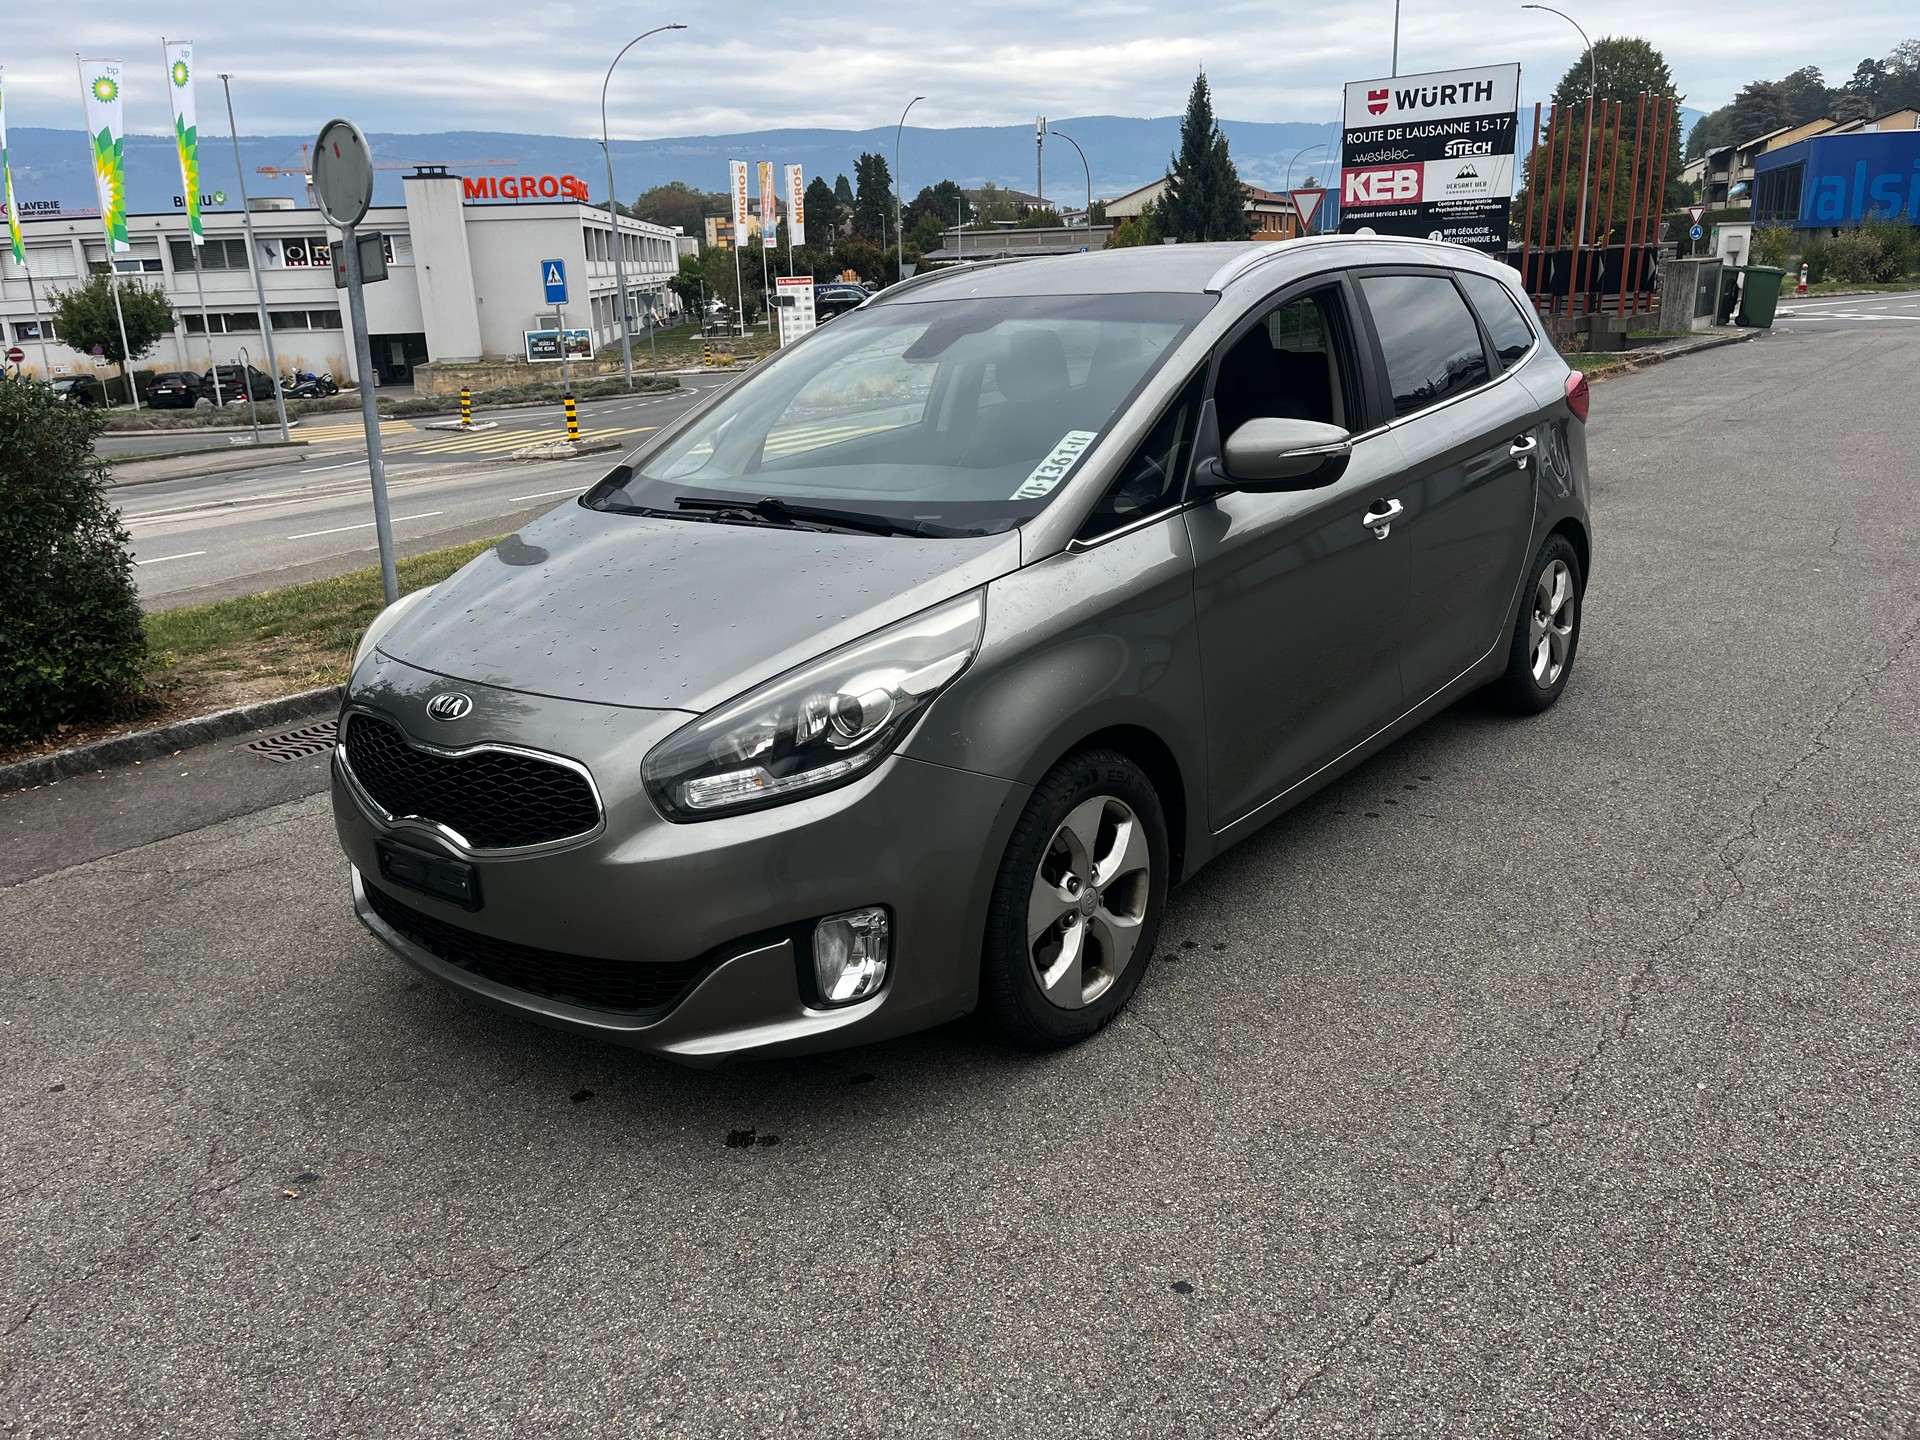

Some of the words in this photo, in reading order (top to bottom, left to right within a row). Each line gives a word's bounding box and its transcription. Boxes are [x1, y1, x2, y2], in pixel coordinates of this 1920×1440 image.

[181, 49, 190, 59] bp
[106, 66, 119, 75] bp
[1347, 130, 1384, 144] ROUTE
[1388, 128, 1402, 140] DE
[1406, 121, 1470, 139] LAUSANNE
[1474, 117, 1511, 133] 15-17
[1352, 147, 1414, 163] westelec
[1444, 141, 1493, 157] SITECH
[463, 174, 577, 199] MIGROS
[1345, 169, 1419, 203] KEB
[738, 165, 746, 225] MIGROS
[793, 167, 803, 224] MIGROS
[17, 200, 60, 210] LAVERIE
[1443, 228, 1457, 236] MFR
